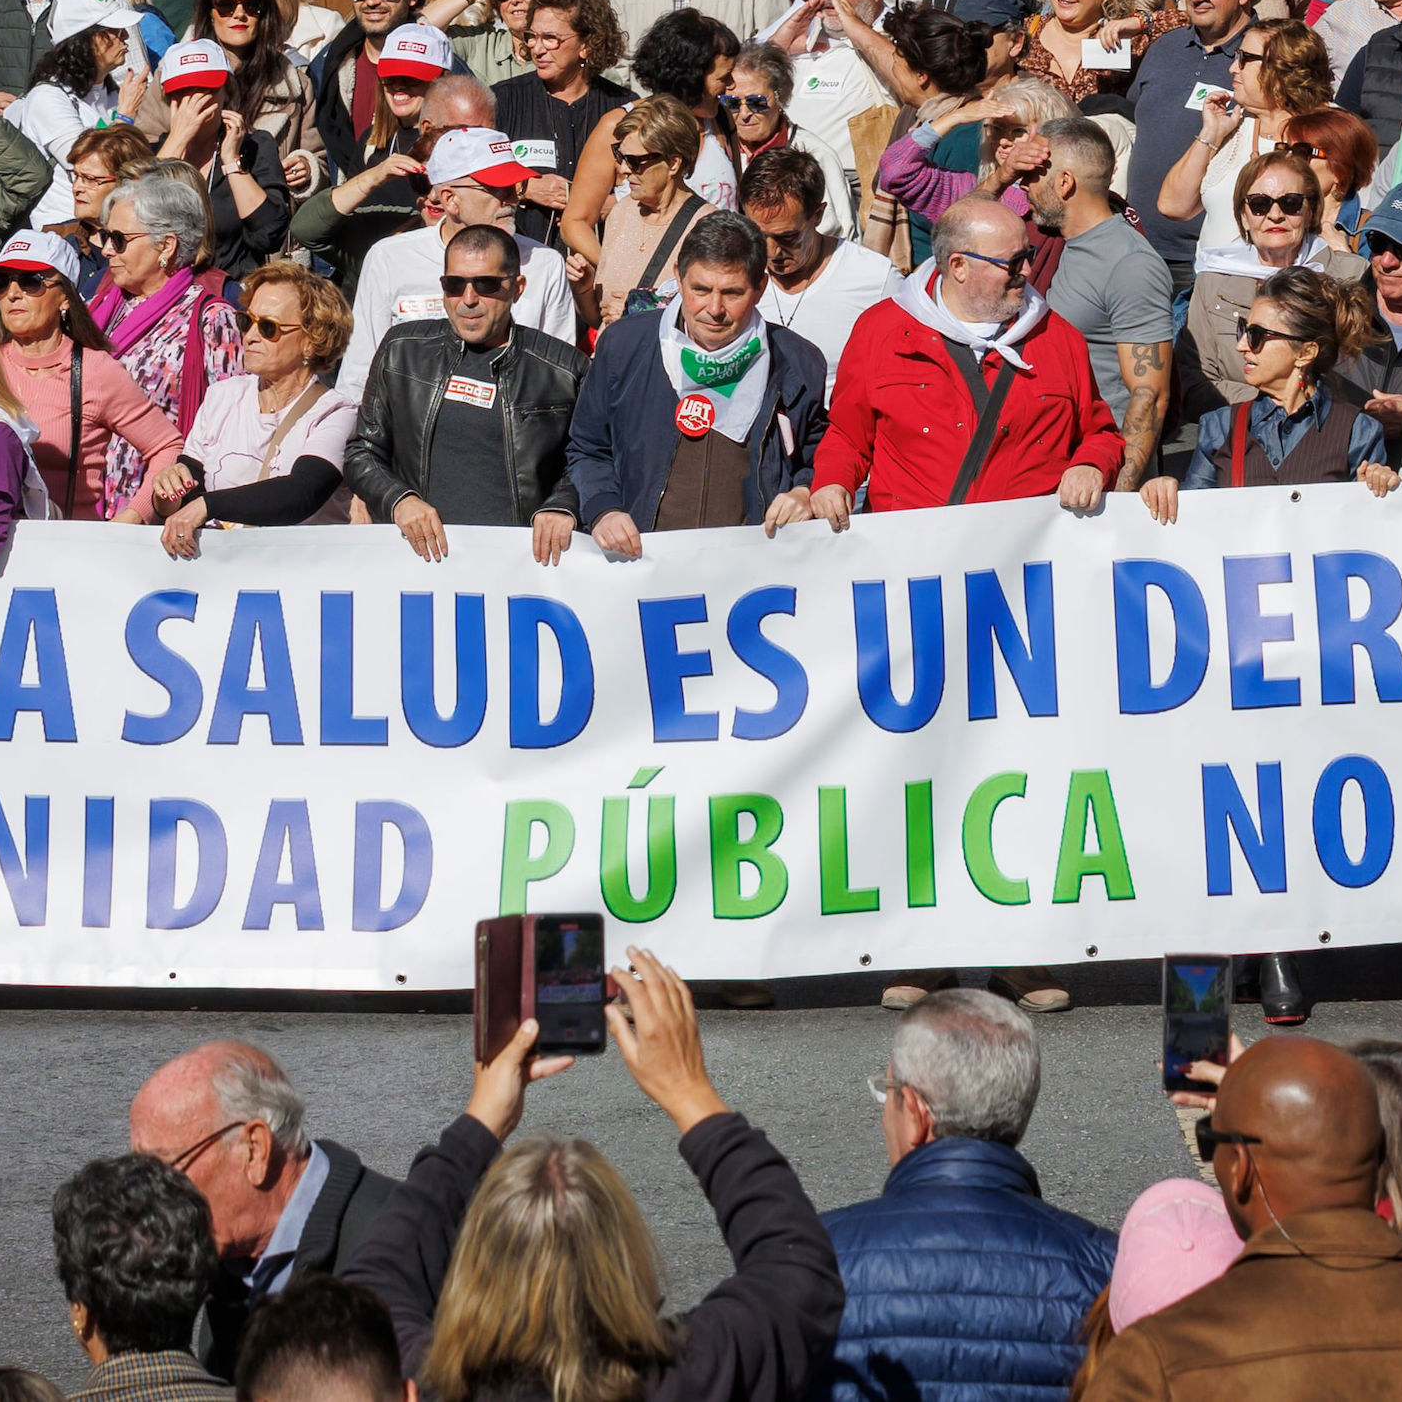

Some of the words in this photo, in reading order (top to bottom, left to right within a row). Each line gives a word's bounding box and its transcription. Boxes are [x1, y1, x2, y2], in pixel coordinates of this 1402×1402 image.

[529, 147, 555, 157] facua
[679, 397, 713, 421] UGT
[121, 588, 596, 750] SALUD
[638, 584, 811, 744] ES
[851, 560, 1060, 735] UN
[499, 765, 1137, 925] PÚBLICA
[1200, 753, 1396, 899] NO
